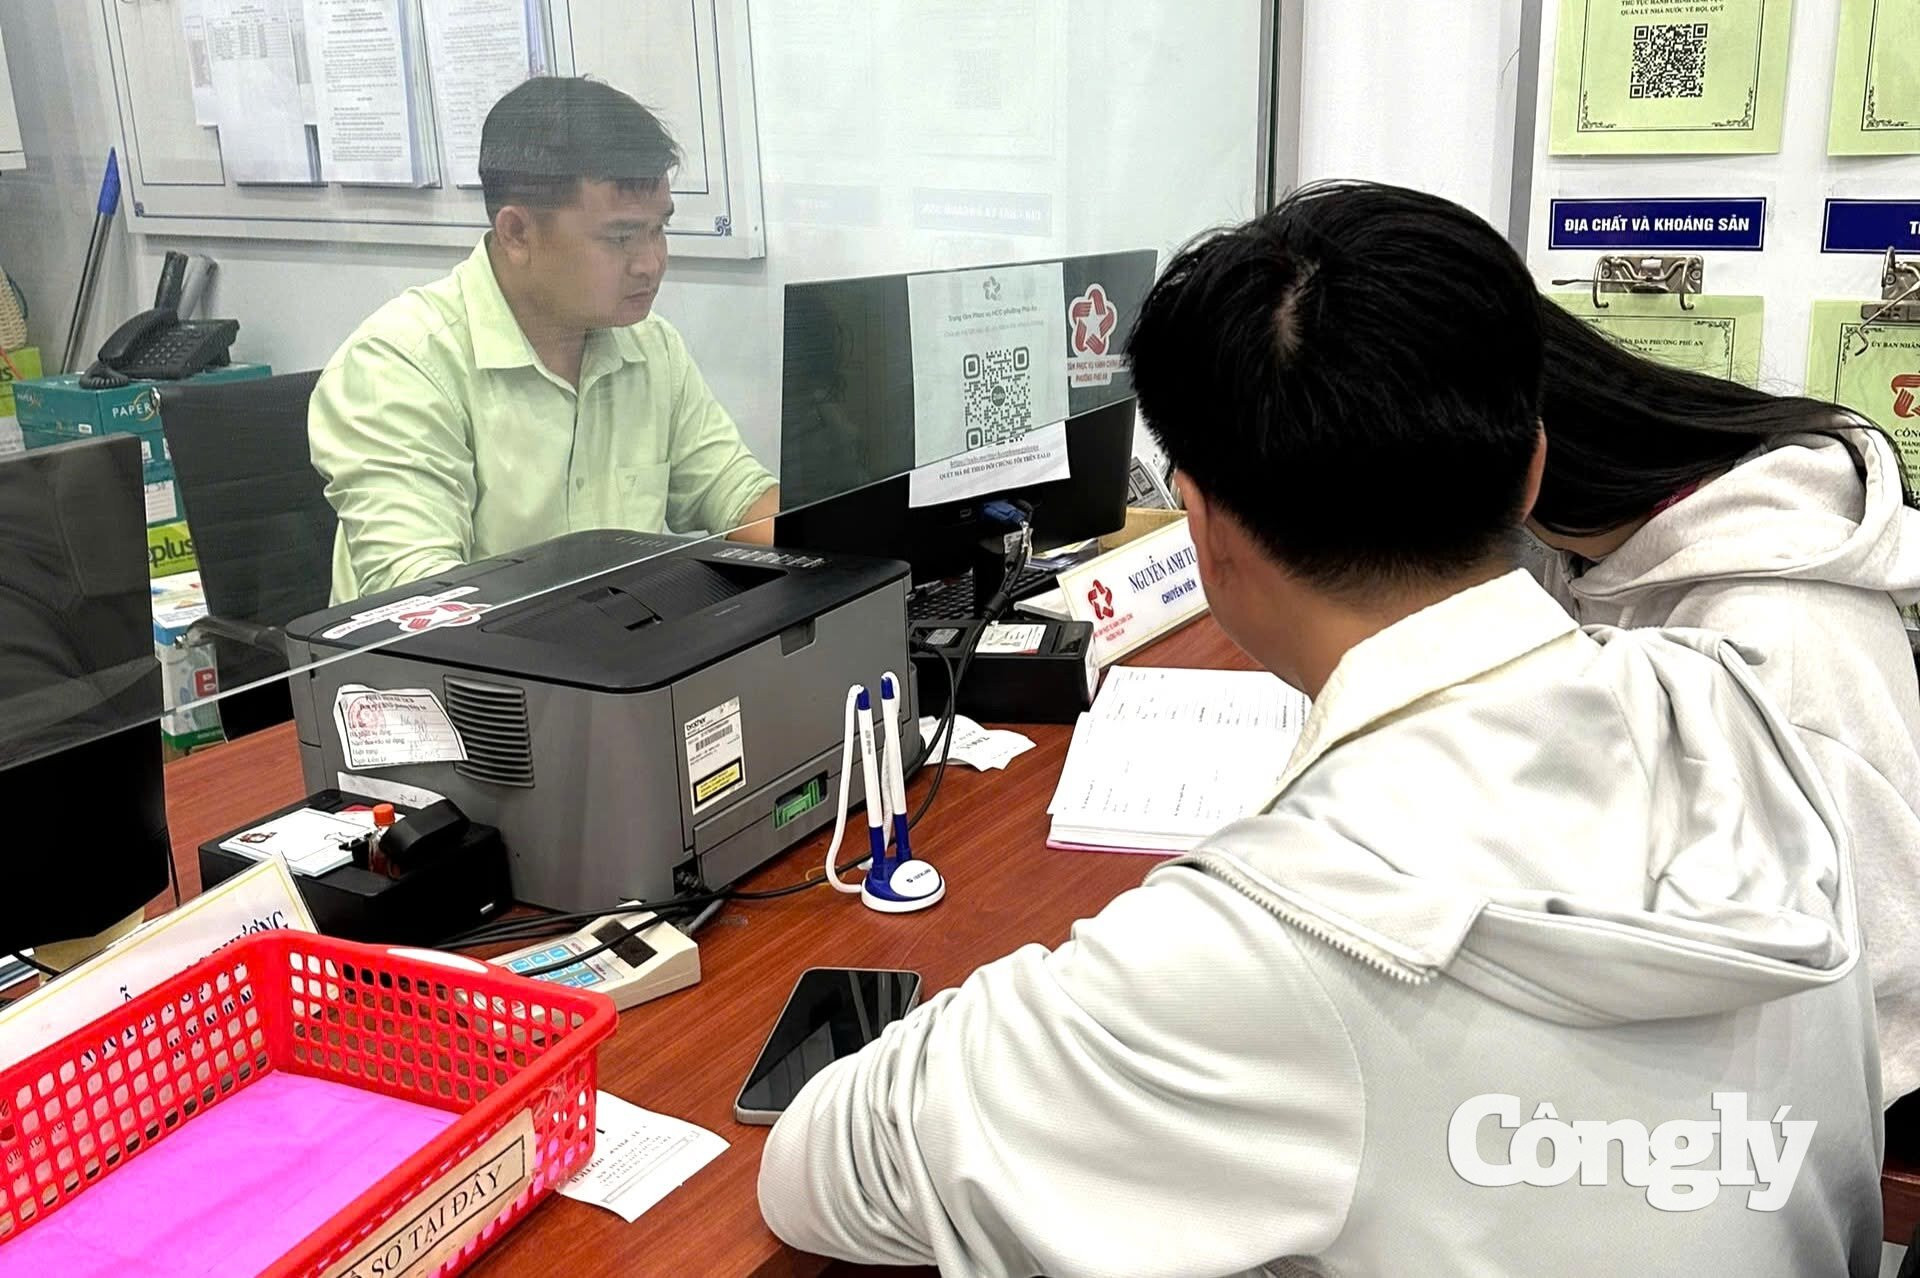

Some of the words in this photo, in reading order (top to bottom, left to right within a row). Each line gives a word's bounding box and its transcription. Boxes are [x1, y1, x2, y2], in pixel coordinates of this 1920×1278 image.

[1564, 218, 1588, 234] ĐỊA
[1592, 214, 1628, 232] CHẤT
[1631, 215, 1650, 232] VÀ
[1654, 215, 1714, 232] KHOÁNG
[1718, 214, 1750, 232] SẢN
[1909, 220, 1920, 235] T
[112, 403, 152, 419] PAPER
[1166, 550, 1187, 575] ANH
[371, 1239, 403, 1278] SƠ
[408, 1206, 446, 1251] TẠI
[451, 1163, 503, 1218] ĐÂY
